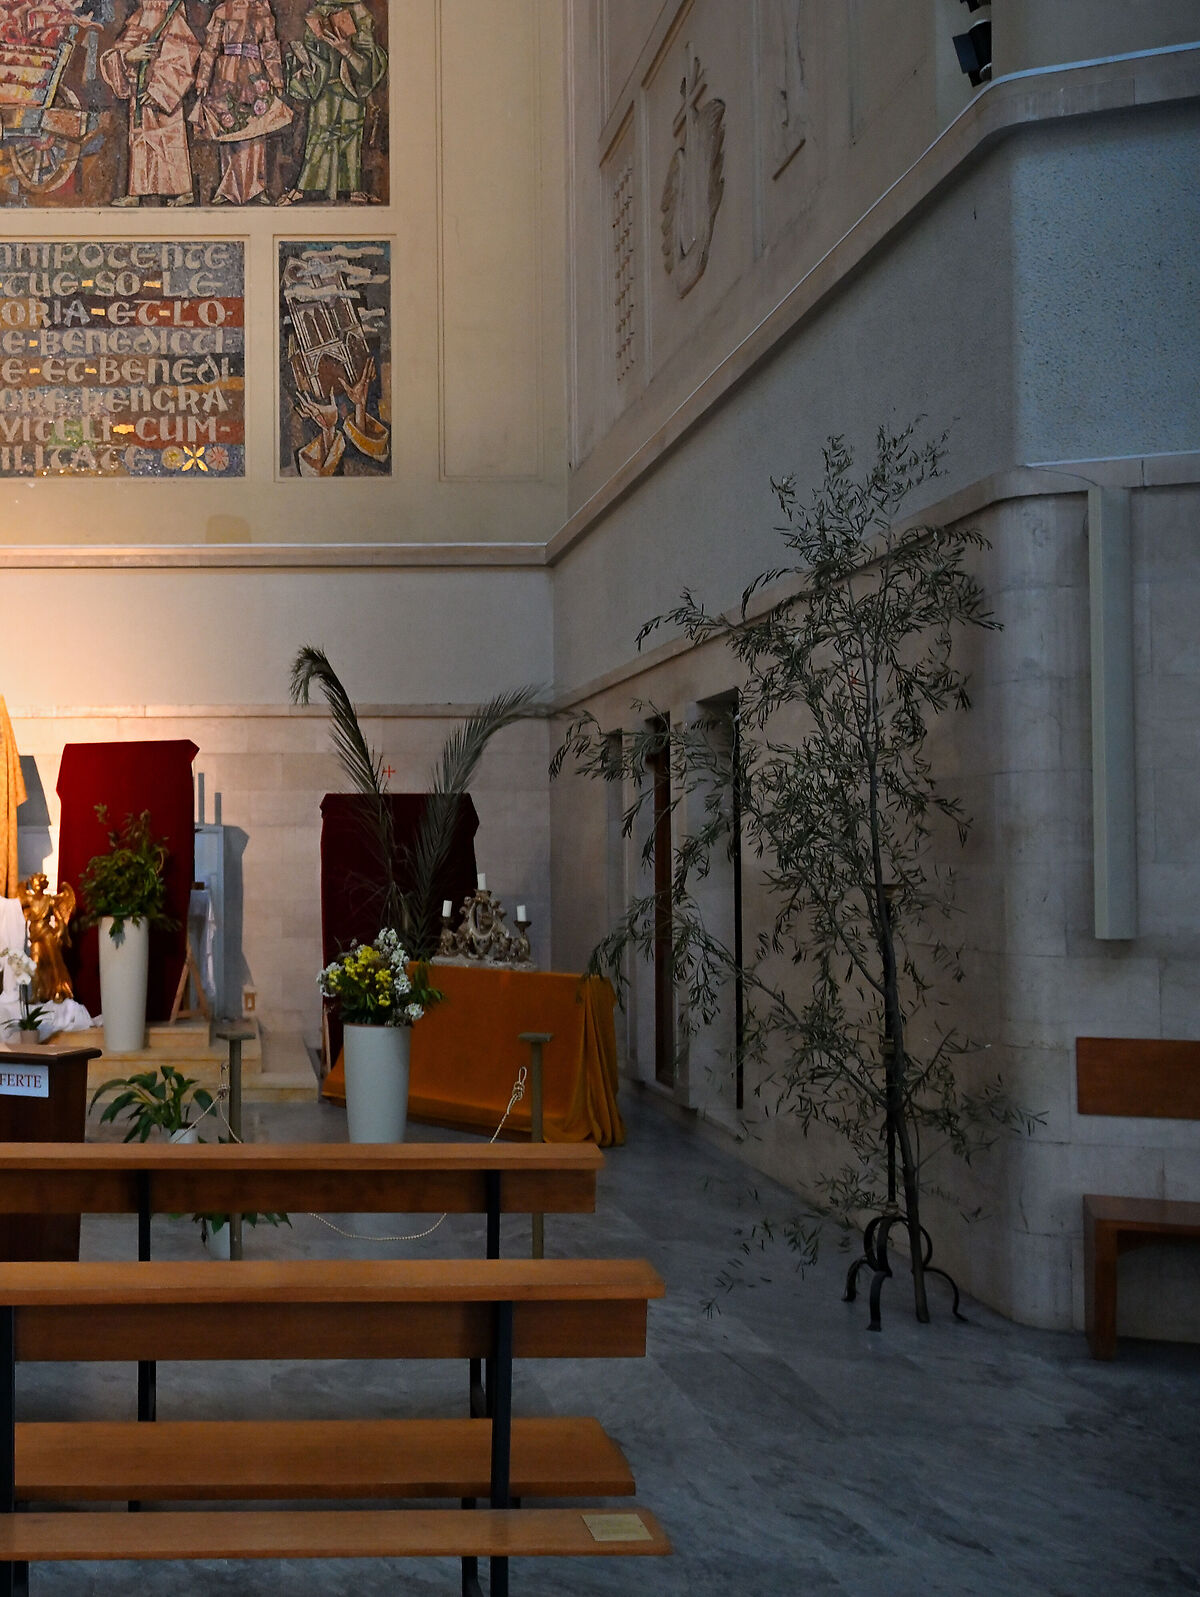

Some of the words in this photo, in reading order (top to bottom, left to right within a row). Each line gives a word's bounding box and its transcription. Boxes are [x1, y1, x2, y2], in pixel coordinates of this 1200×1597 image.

[0, 271, 79, 297] TUE
[94, 271, 141, 297] SO
[162, 271, 224, 297] LE
[107, 300, 161, 326] ET
[42, 358, 87, 383] ET
